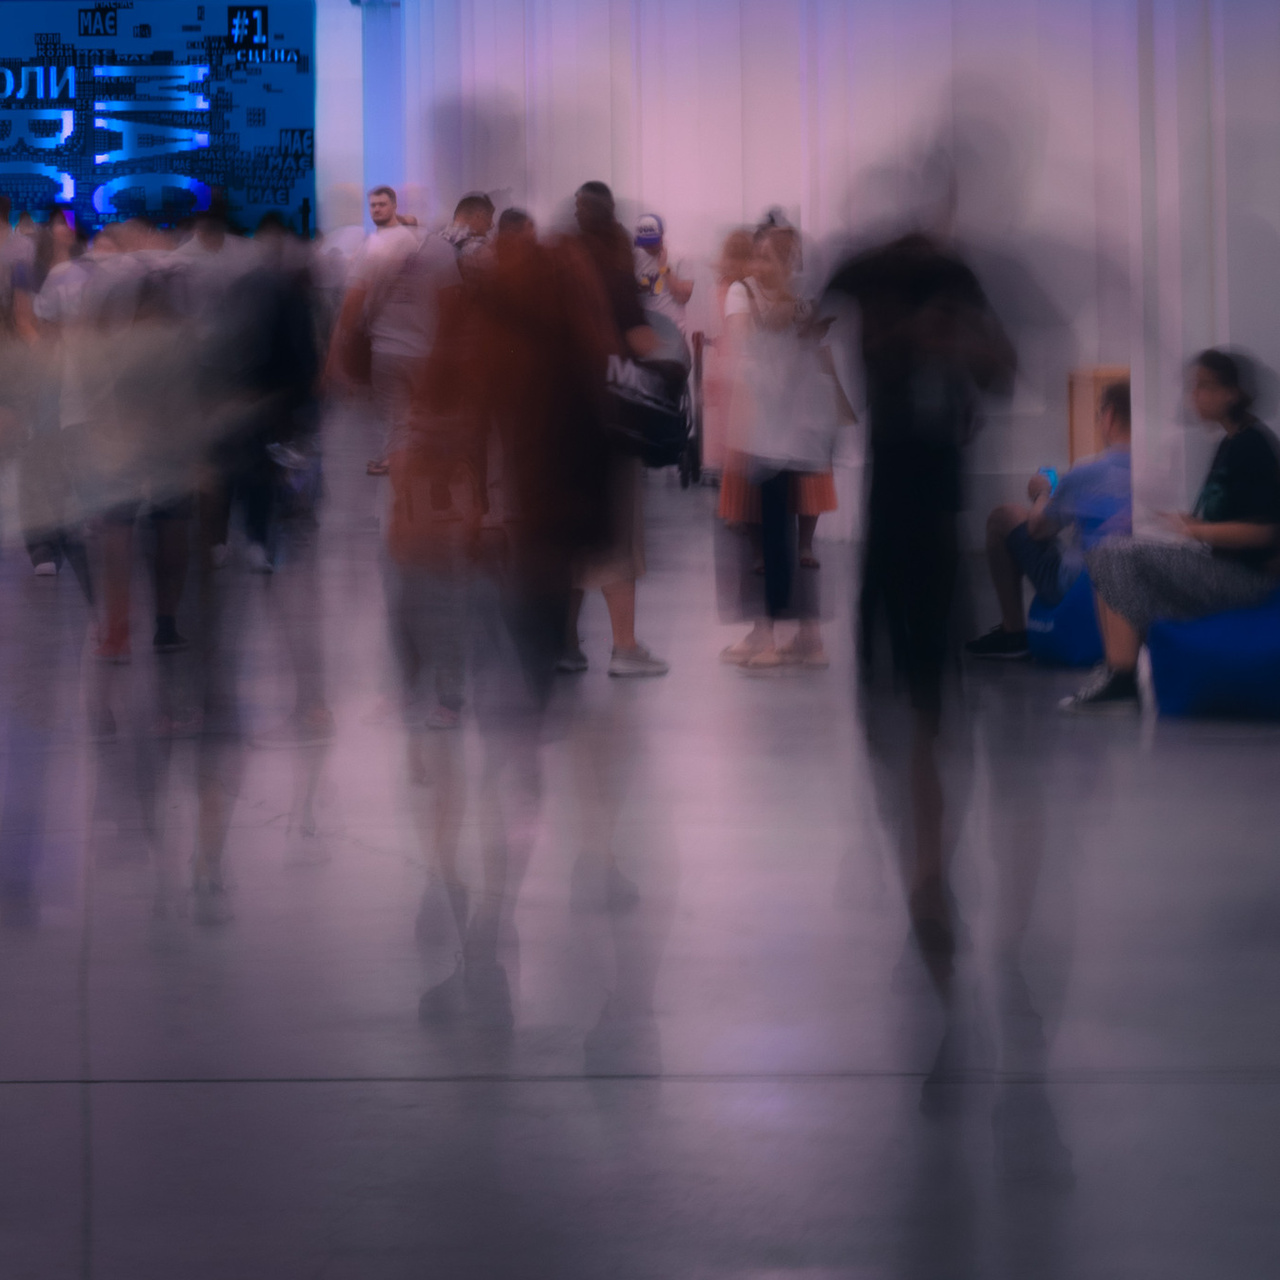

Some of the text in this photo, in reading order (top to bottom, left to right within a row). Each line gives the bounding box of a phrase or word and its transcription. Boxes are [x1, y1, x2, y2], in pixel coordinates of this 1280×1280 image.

[80, 12, 115, 34] МАЄ
[231, 10, 266, 44] #1
[236, 49, 297, 64] СЦЕНА
[281, 131, 313, 154] МАЄ
